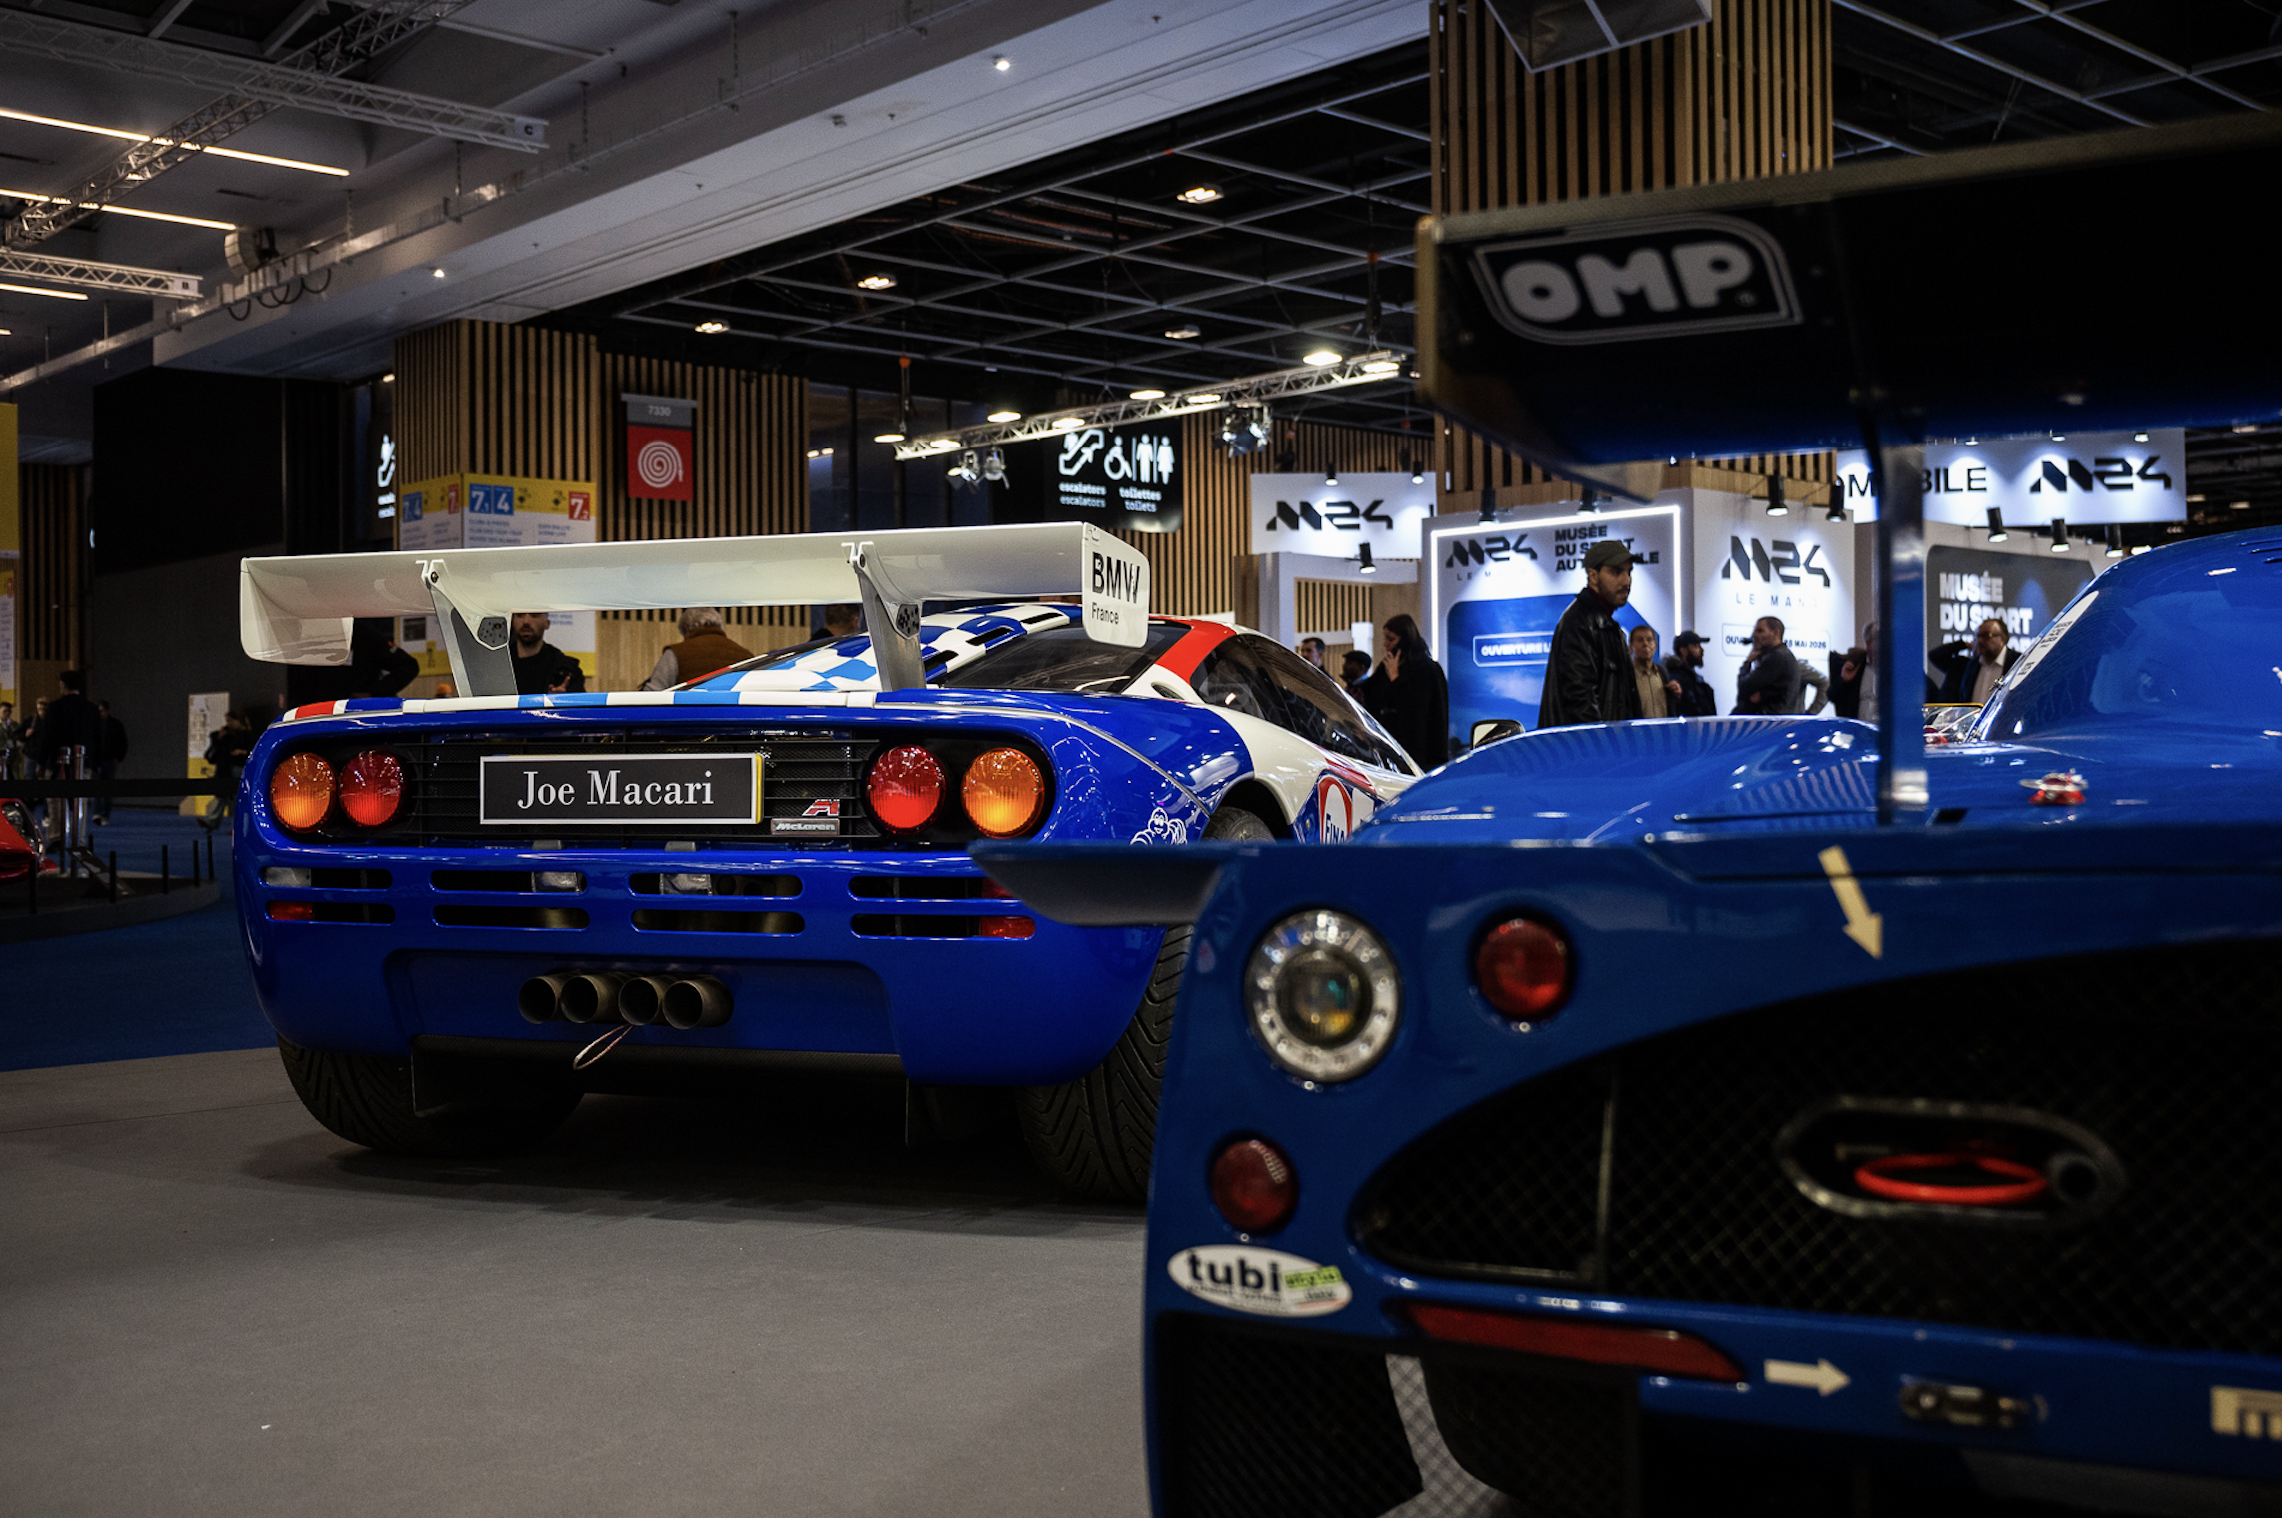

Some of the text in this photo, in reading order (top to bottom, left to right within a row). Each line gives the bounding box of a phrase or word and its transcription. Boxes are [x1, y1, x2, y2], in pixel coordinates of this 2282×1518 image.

[524, 124, 534, 136] C
[1501, 241, 1753, 323] OMP
[648, 405, 672, 417] 7330
[2029, 455, 2172, 493] M24
[1058, 481, 1107, 495] escalators
[1118, 486, 1162, 501] toilettes
[497, 492, 510, 513] 4
[1059, 495, 1107, 508] escalators
[1125, 499, 1157, 512] toilets
[1266, 499, 1394, 531] M24
[1555, 523, 1608, 542] MUSÉE
[1446, 533, 1538, 568] M24
[1555, 544, 1576, 557] DU
[1721, 535, 1831, 588] M24
[1092, 551, 1141, 604] BMW
[1939, 570, 2004, 603] MUSÉE
[1091, 602, 1119, 625] France
[1939, 603, 1968, 632] DU
[1481, 642, 1543, 657] OUVERTURE
[1794, 640, 1808, 648] MAI
[1809, 641, 1827, 649] 2026
[517, 769, 715, 809] Joe Macari
[776, 822, 836, 831] McLaren
[1187, 1252, 1281, 1293] tubi
